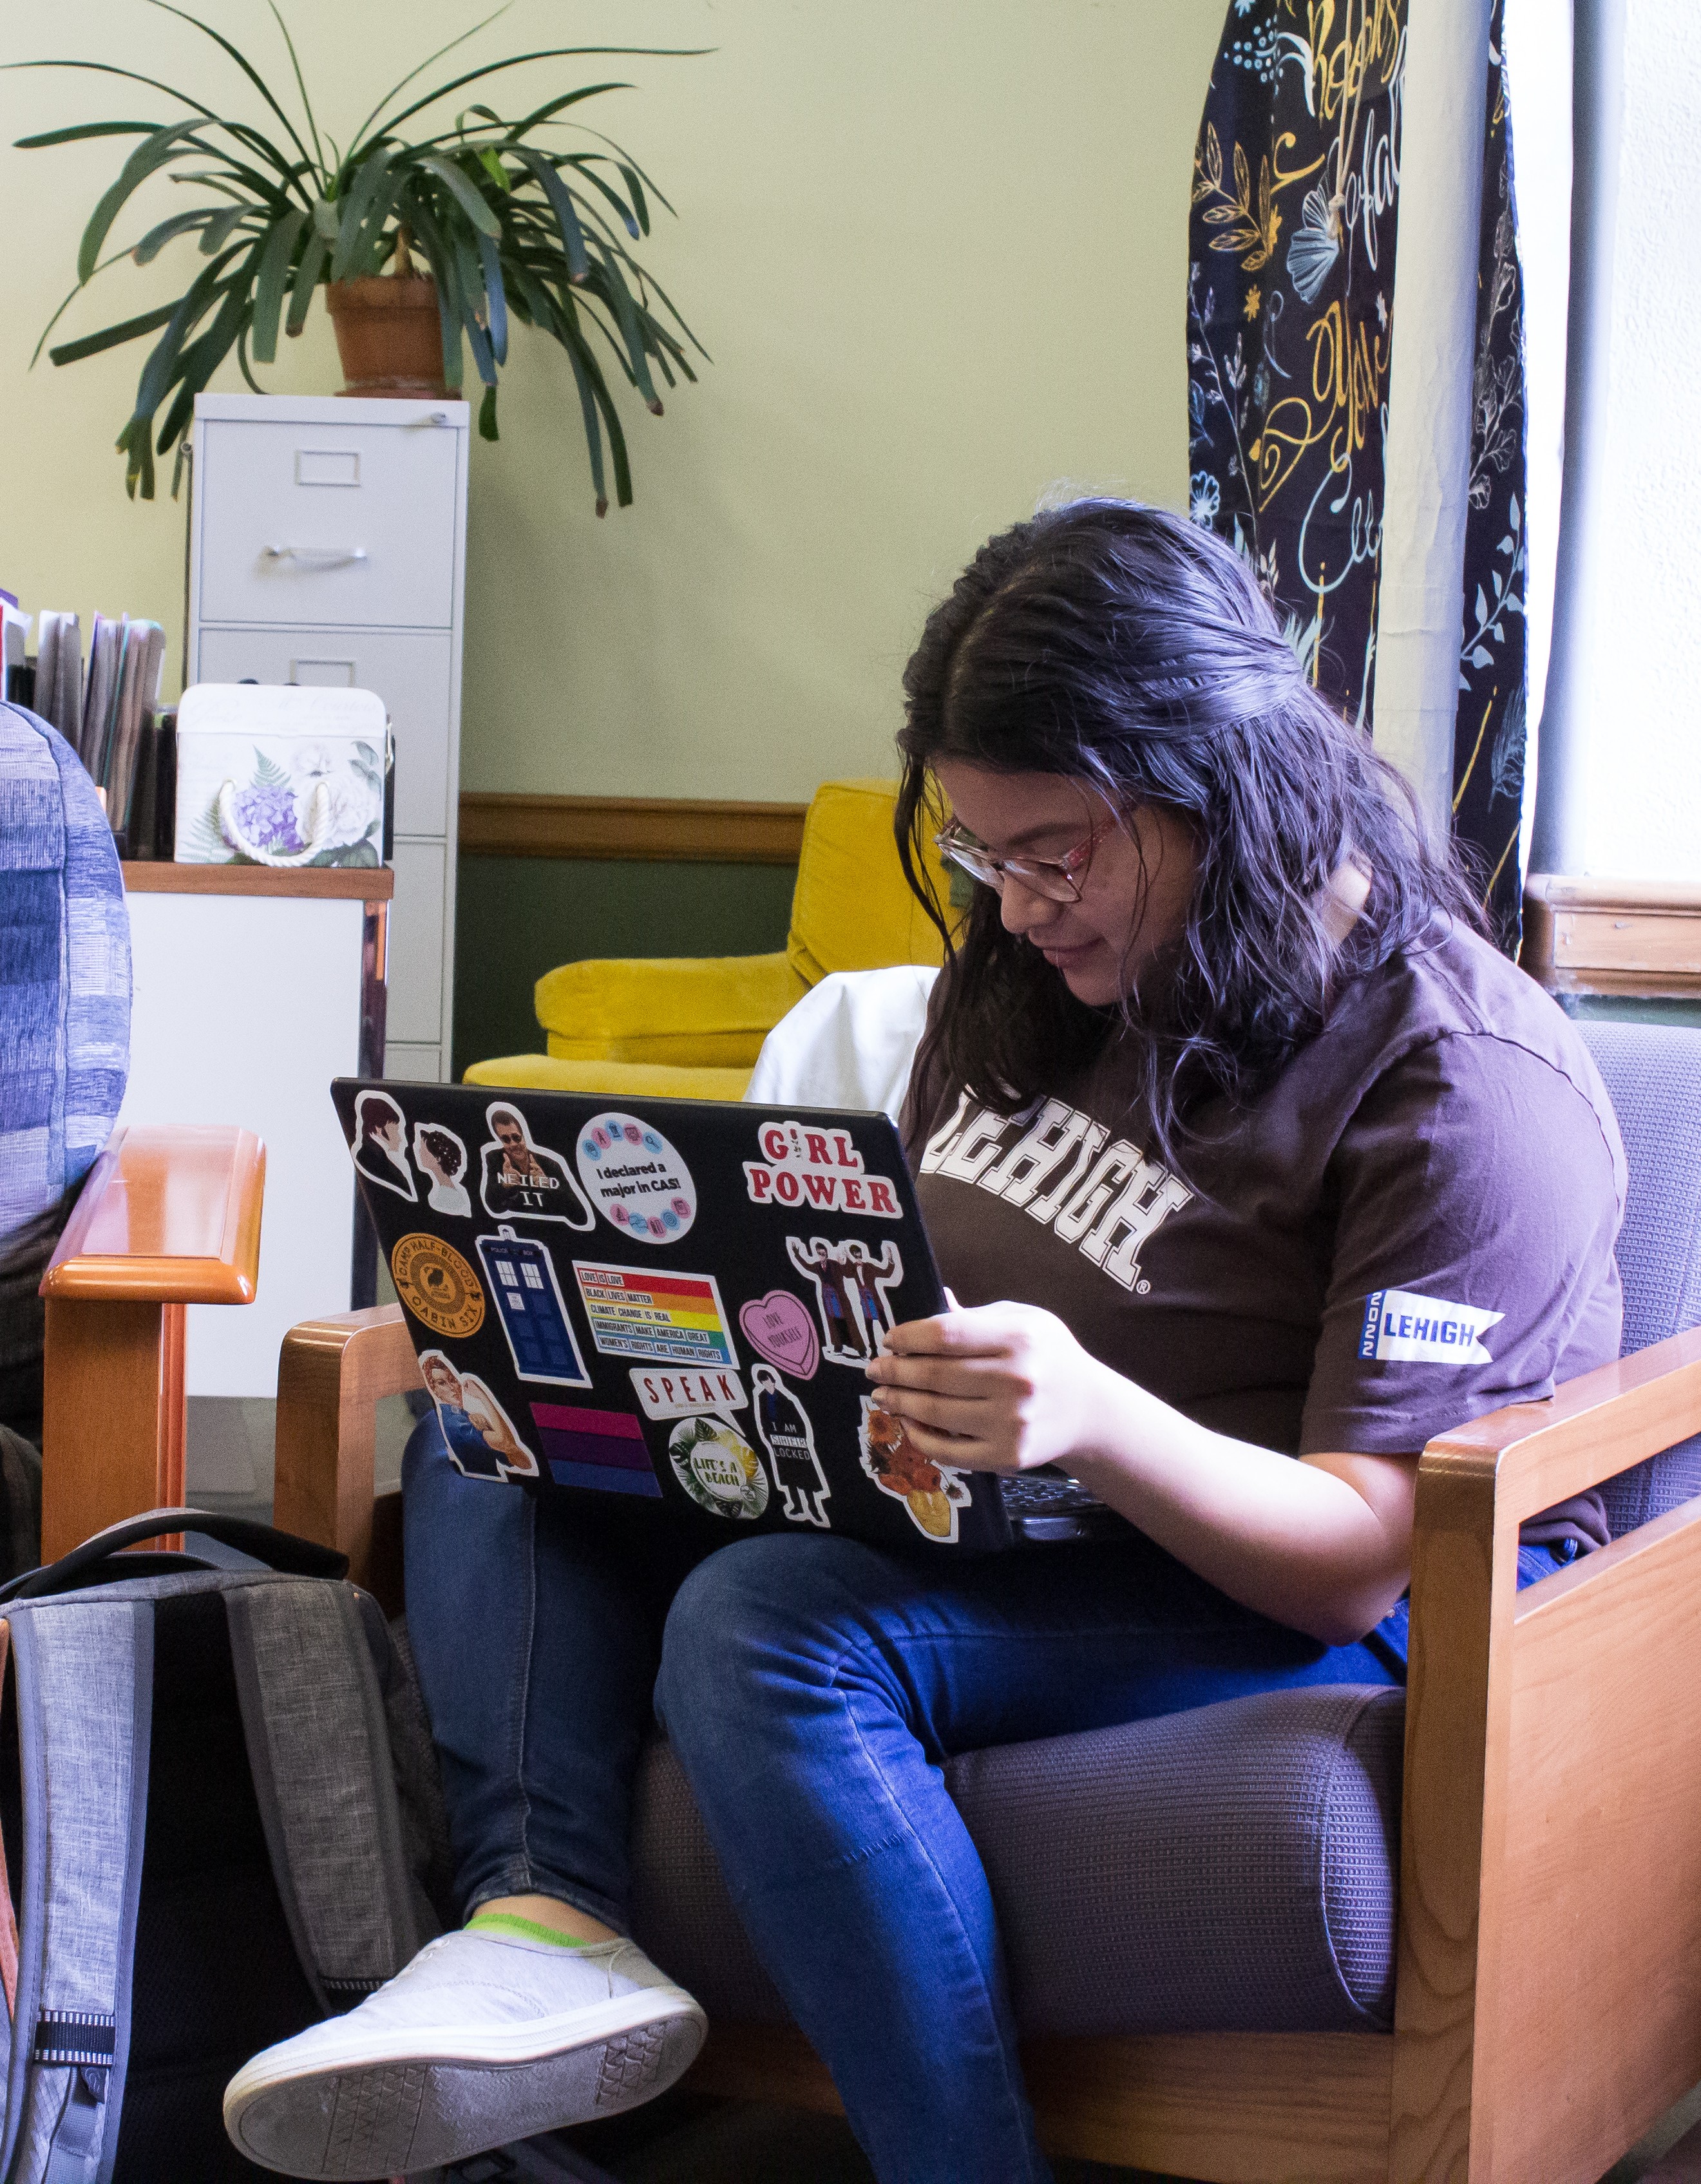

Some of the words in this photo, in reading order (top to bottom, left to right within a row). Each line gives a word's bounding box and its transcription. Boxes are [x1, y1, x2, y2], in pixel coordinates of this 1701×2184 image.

[596, 1168, 603, 1179] I
[603, 1162, 657, 1179] declared
[658, 1163, 667, 1173] a
[497, 1172, 560, 1189] NEILED
[600, 1183, 636, 1198] major
[636, 1181, 651, 1193] in
[651, 1177, 681, 1192] CAS!
[520, 1192, 543, 1206] IT
[749, 1169, 896, 1213] POWER
[920, 1091, 1194, 1291] LEHIGH
[581, 1272, 596, 1282] LOVE
[599, 1274, 606, 1283] IS
[608, 1275, 623, 1285] LOVE
[586, 1288, 605, 1298] BLACK
[608, 1291, 625, 1301] LIVES
[627, 1293, 652, 1304] MATTER
[412, 1296, 457, 1329] CABIN
[591, 1304, 615, 1315] CLIMATE
[618, 1308, 642, 1318] CHANGE
[645, 1311, 652, 1320] IS
[654, 1312, 670, 1322] REAL
[596, 1321, 632, 1333] IMMIGRANTS
[636, 1325, 654, 1336] MAKE
[656, 1327, 685, 1340] AMERICA
[687, 1332, 707, 1342] GREAT
[1362, 1292, 1382, 1356] 2022
[1383, 1313, 1475, 1347] LEHIGH
[600, 1336, 628, 1348] WOMEN'S
[631, 1340, 653, 1351] RIGHTS
[656, 1344, 669, 1353] ARE
[672, 1345, 695, 1356] HUMAN
[698, 1349, 721, 1360] RIGHTS
[643, 1374, 736, 1403] SPEAK
[772, 1422, 777, 1431] I
[784, 1423, 797, 1433] AM
[772, 1435, 806, 1448] SHER
[774, 1448, 810, 1460] LOCKED
[729, 1462, 737, 1473] A
[705, 1472, 740, 1486] BEACH
